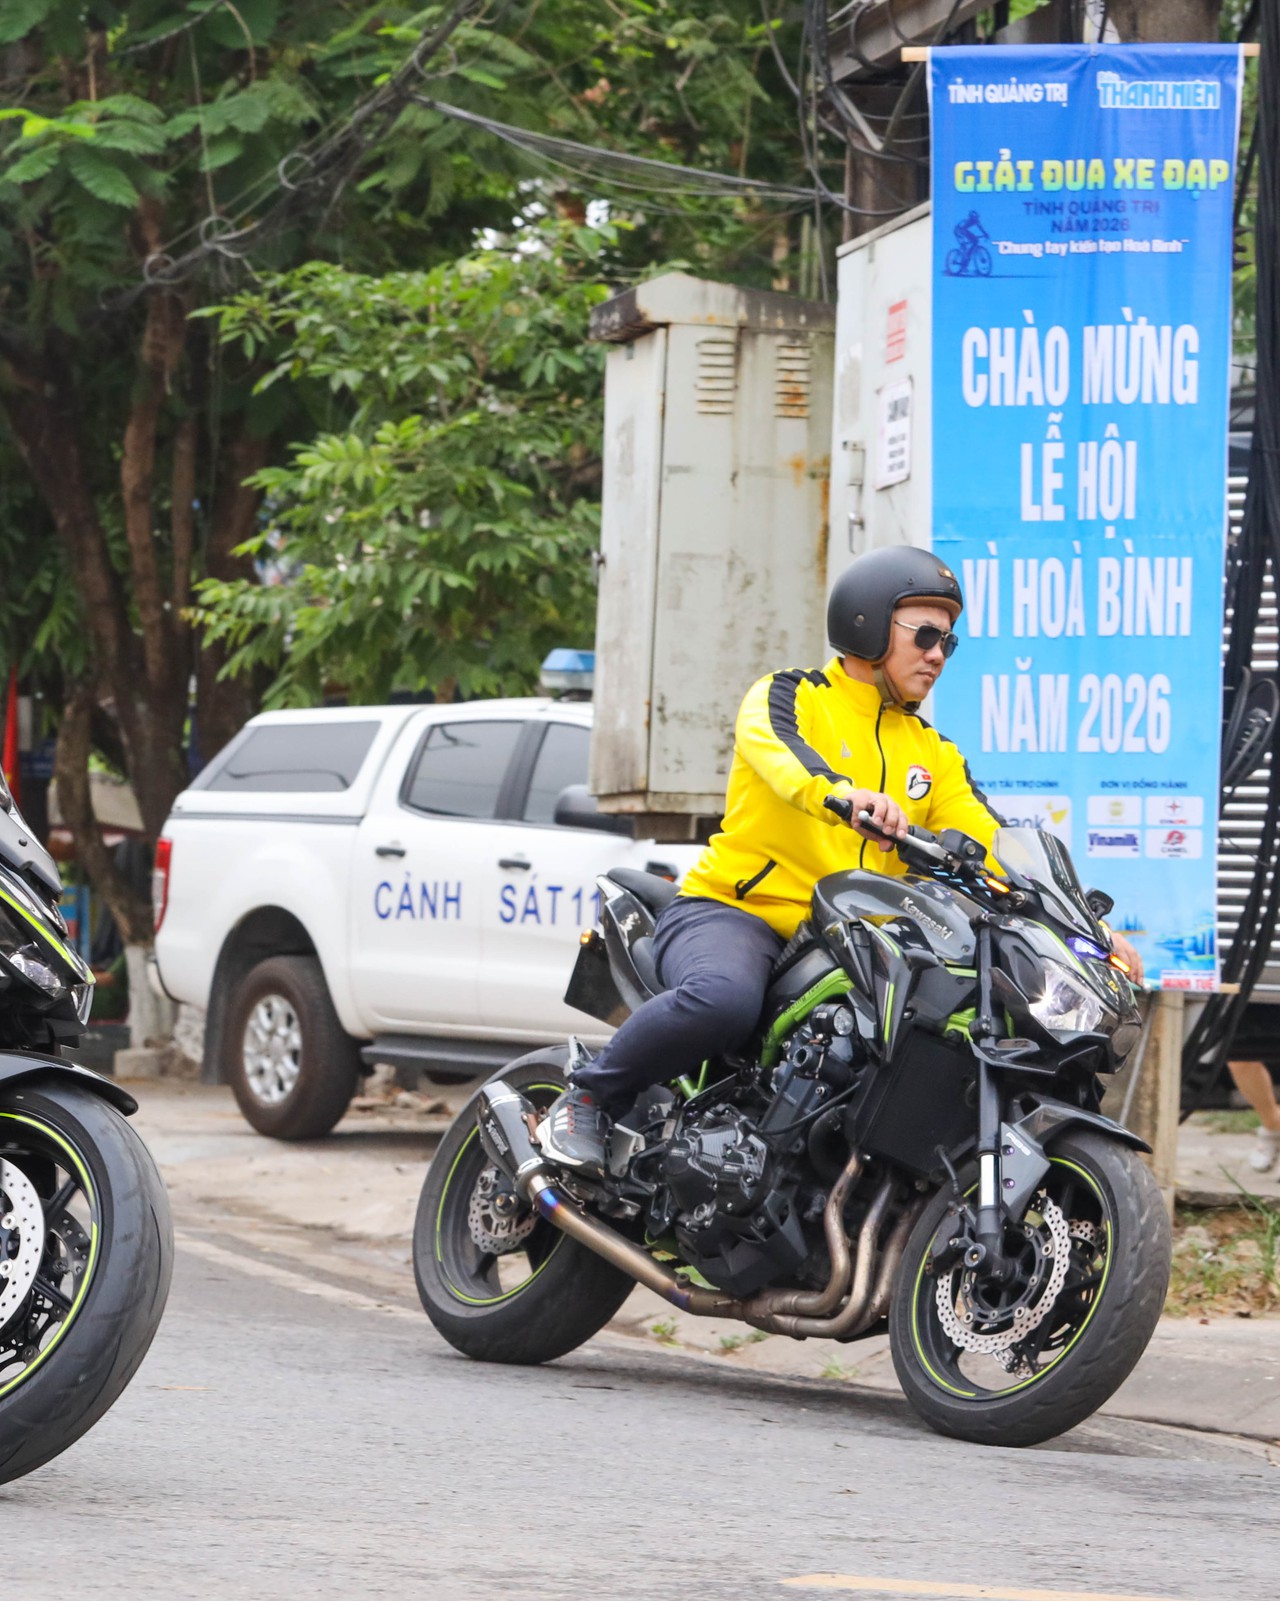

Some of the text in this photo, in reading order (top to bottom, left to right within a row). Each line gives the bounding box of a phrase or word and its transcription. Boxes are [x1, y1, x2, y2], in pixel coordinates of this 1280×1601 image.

[985, 77, 1044, 103] QUẢNG
[1044, 83, 1068, 107] TRỊ
[954, 148, 1230, 200] GIẢI ĐUA XE ĐẠP
[961, 309, 1070, 408] CHÀO
[1083, 306, 1200, 406] MỪNG
[1020, 412, 1137, 540] LỄ HỘI
[962, 539, 1193, 639] VÌ HOÀ BÌNH
[981, 656, 1172, 755] NĂM 2026
[1088, 833, 1139, 847] Vinamilk
[374, 871, 601, 927] CẢNH SÁT 11
[900, 896, 954, 941] Kawasaki
